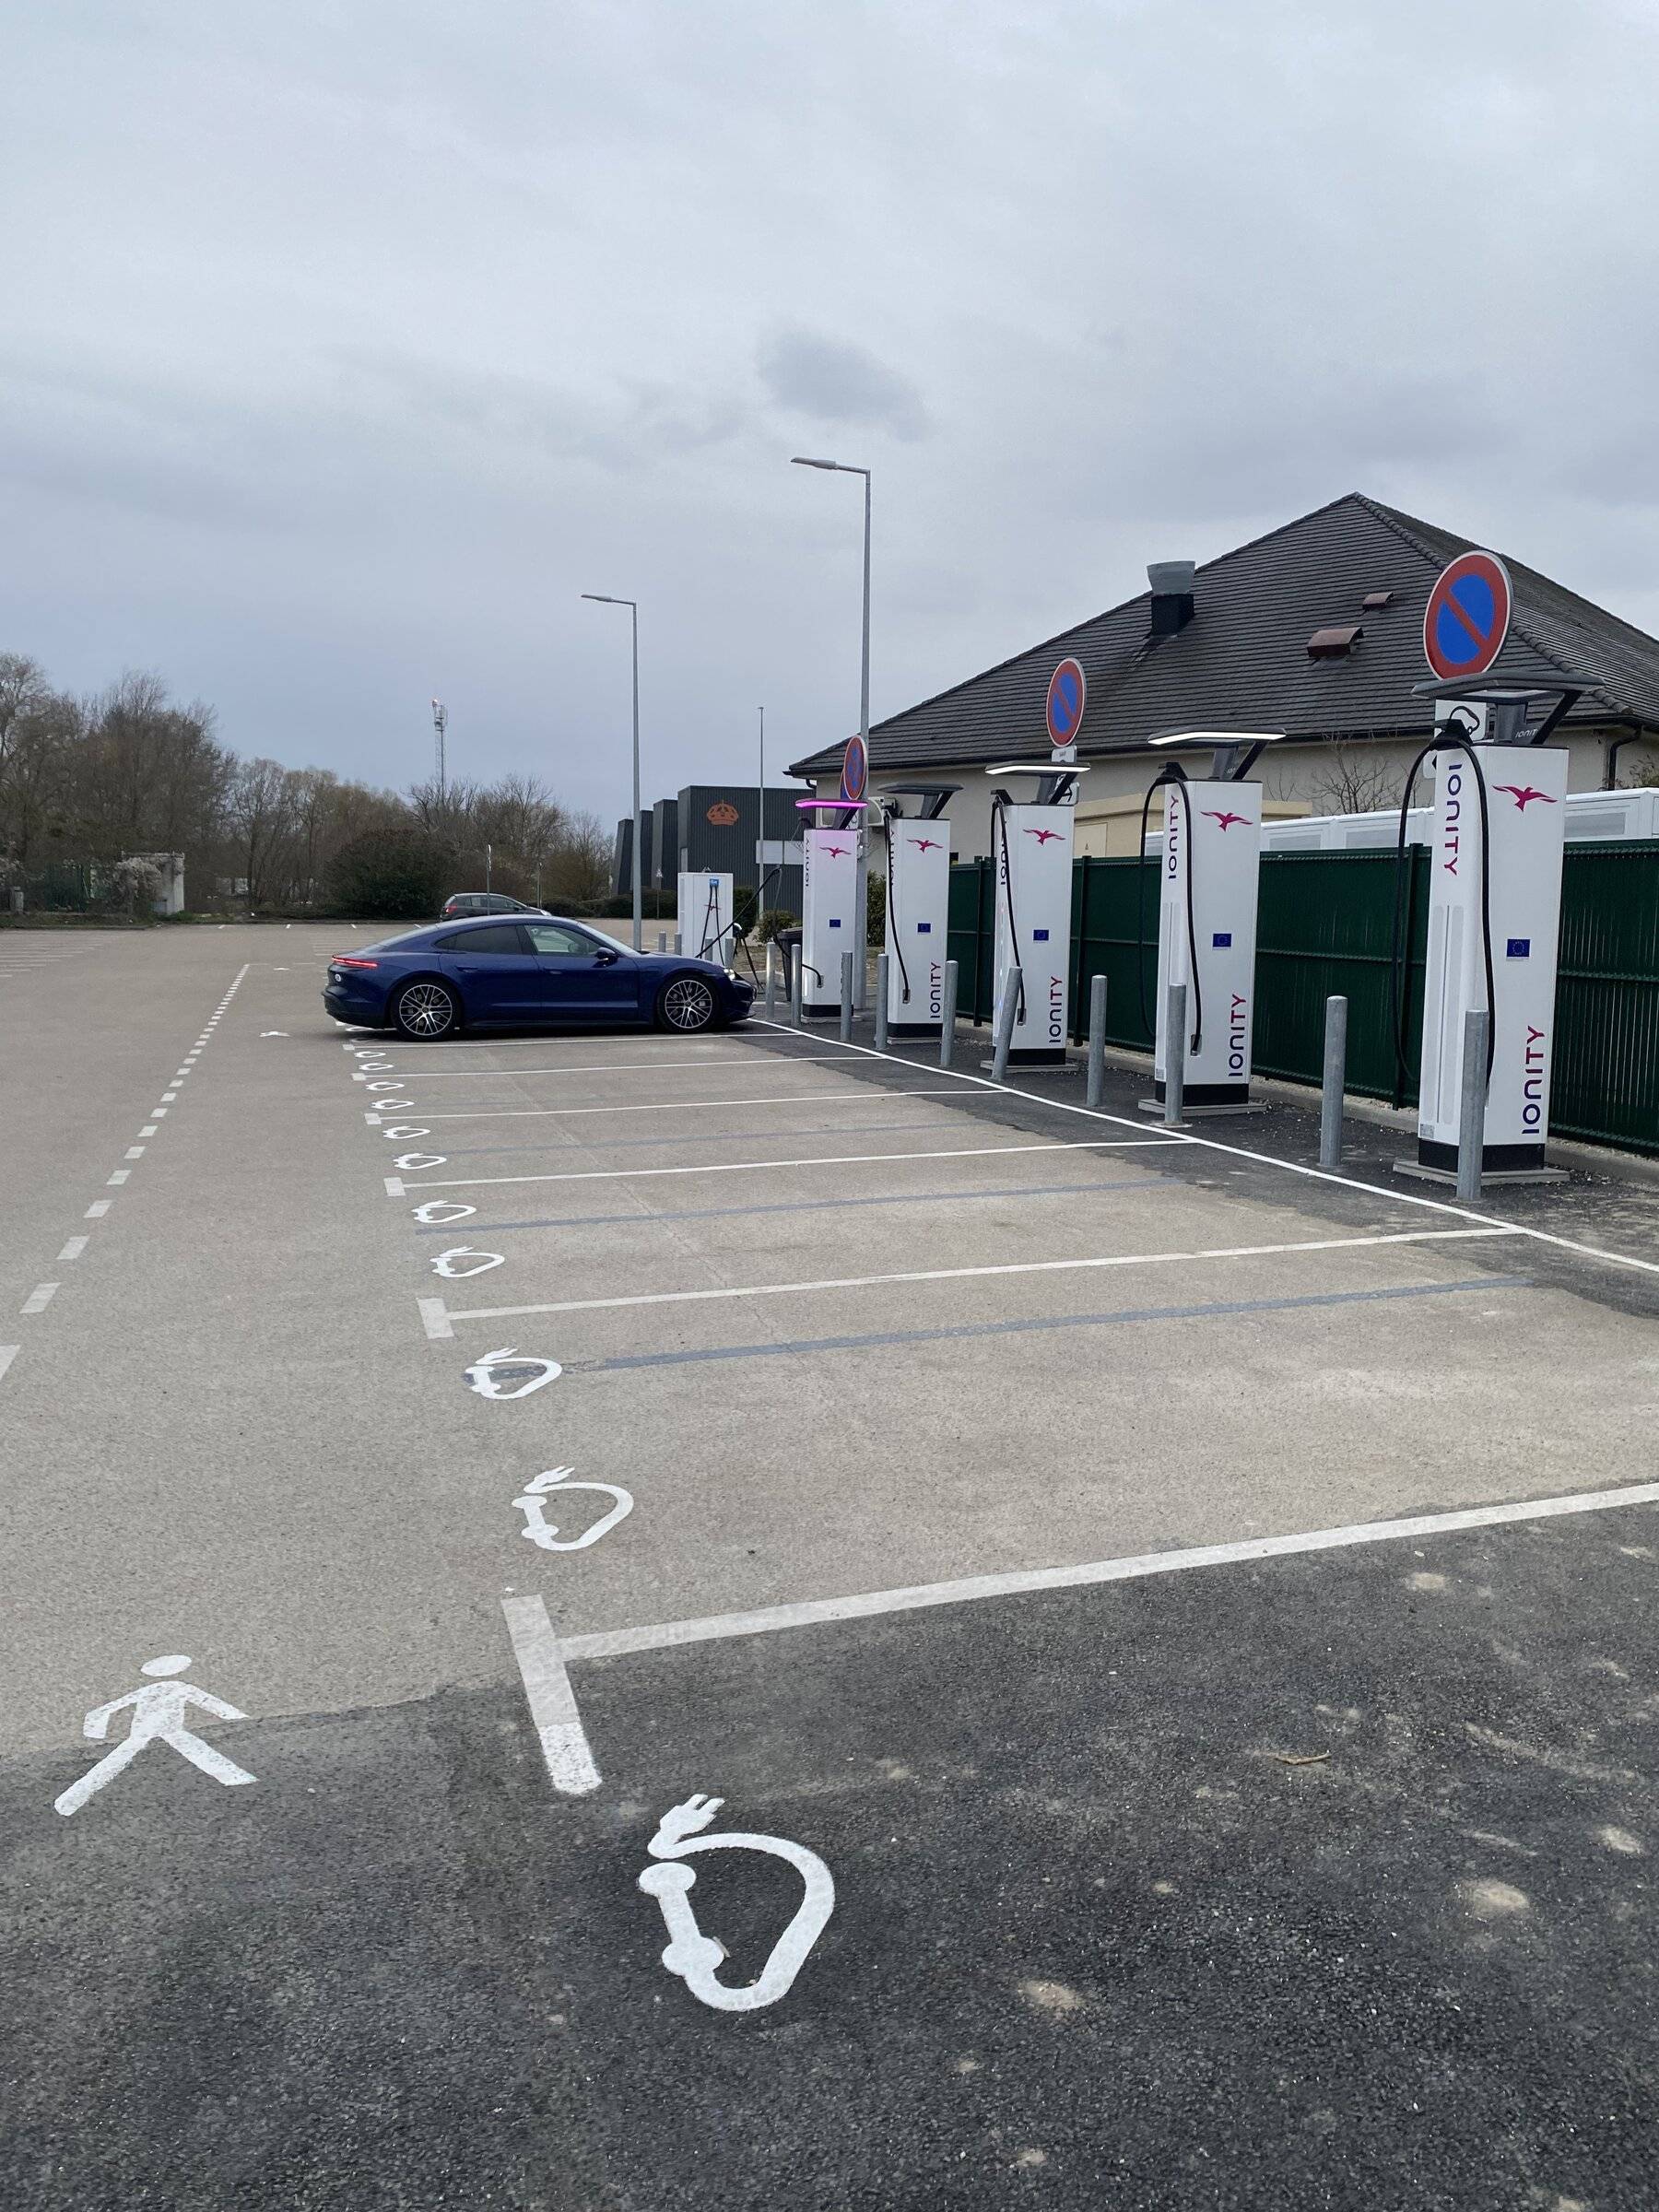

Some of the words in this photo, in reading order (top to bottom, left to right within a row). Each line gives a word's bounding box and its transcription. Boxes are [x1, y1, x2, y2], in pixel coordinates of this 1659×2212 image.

[1515, 728, 1538, 738] IONIT
[1168, 794, 1179, 879] IONITY
[1443, 763, 1463, 876] IONITY
[930, 962, 941, 1018] IONITY
[1049, 976, 1062, 1042] IONITY
[1228, 994, 1246, 1077] IONITY
[1522, 1025, 1545, 1135] IONITY
